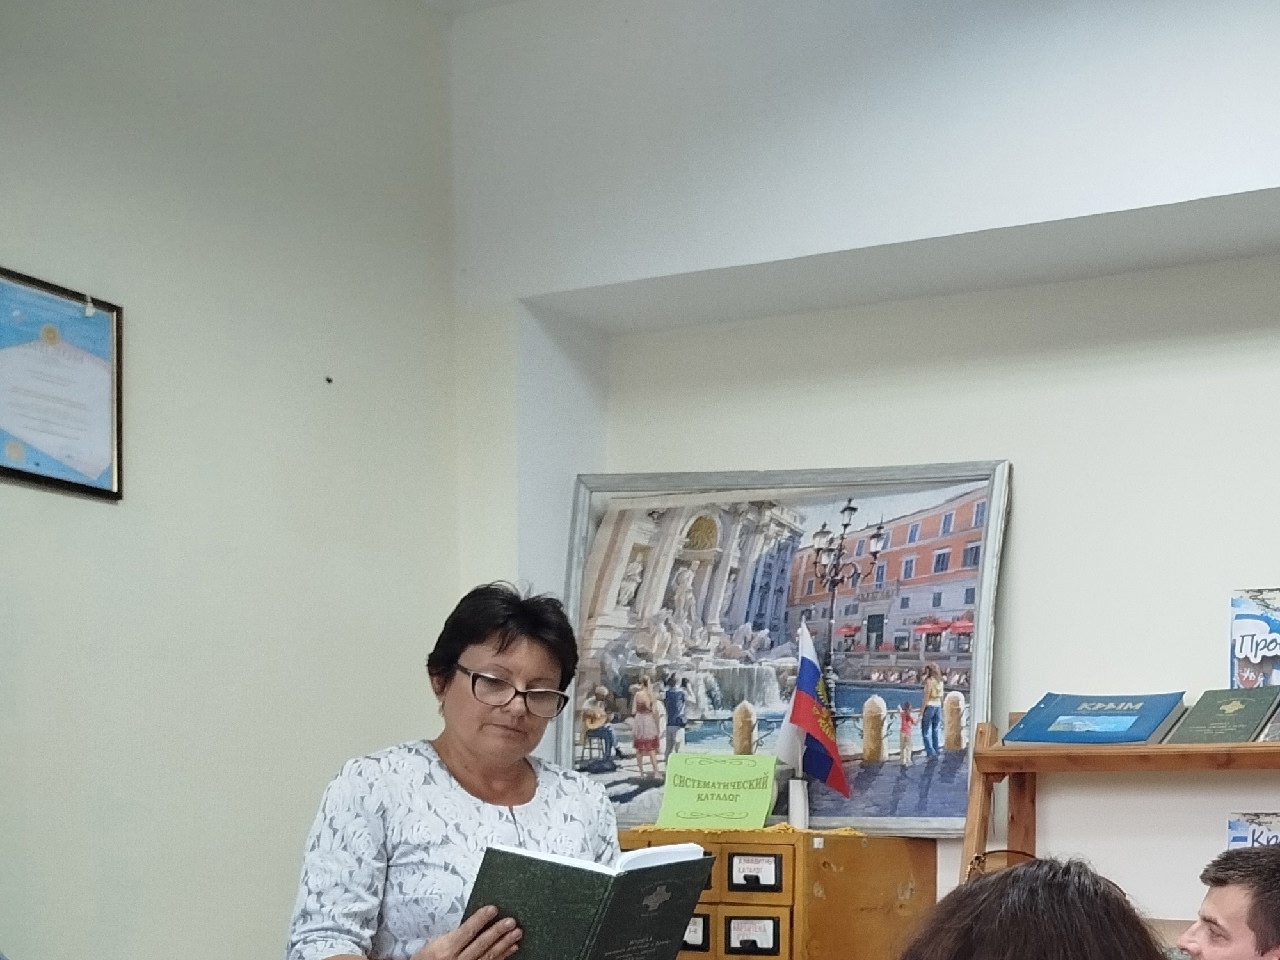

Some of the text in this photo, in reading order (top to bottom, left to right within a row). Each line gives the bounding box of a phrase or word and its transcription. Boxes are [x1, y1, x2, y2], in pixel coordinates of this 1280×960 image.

[1076, 702, 1145, 711] КРЫМ
[673, 771, 769, 789] СИСТЕМАТИЧЕСКИЙ
[696, 793, 741, 802] КАТАЛОГ
